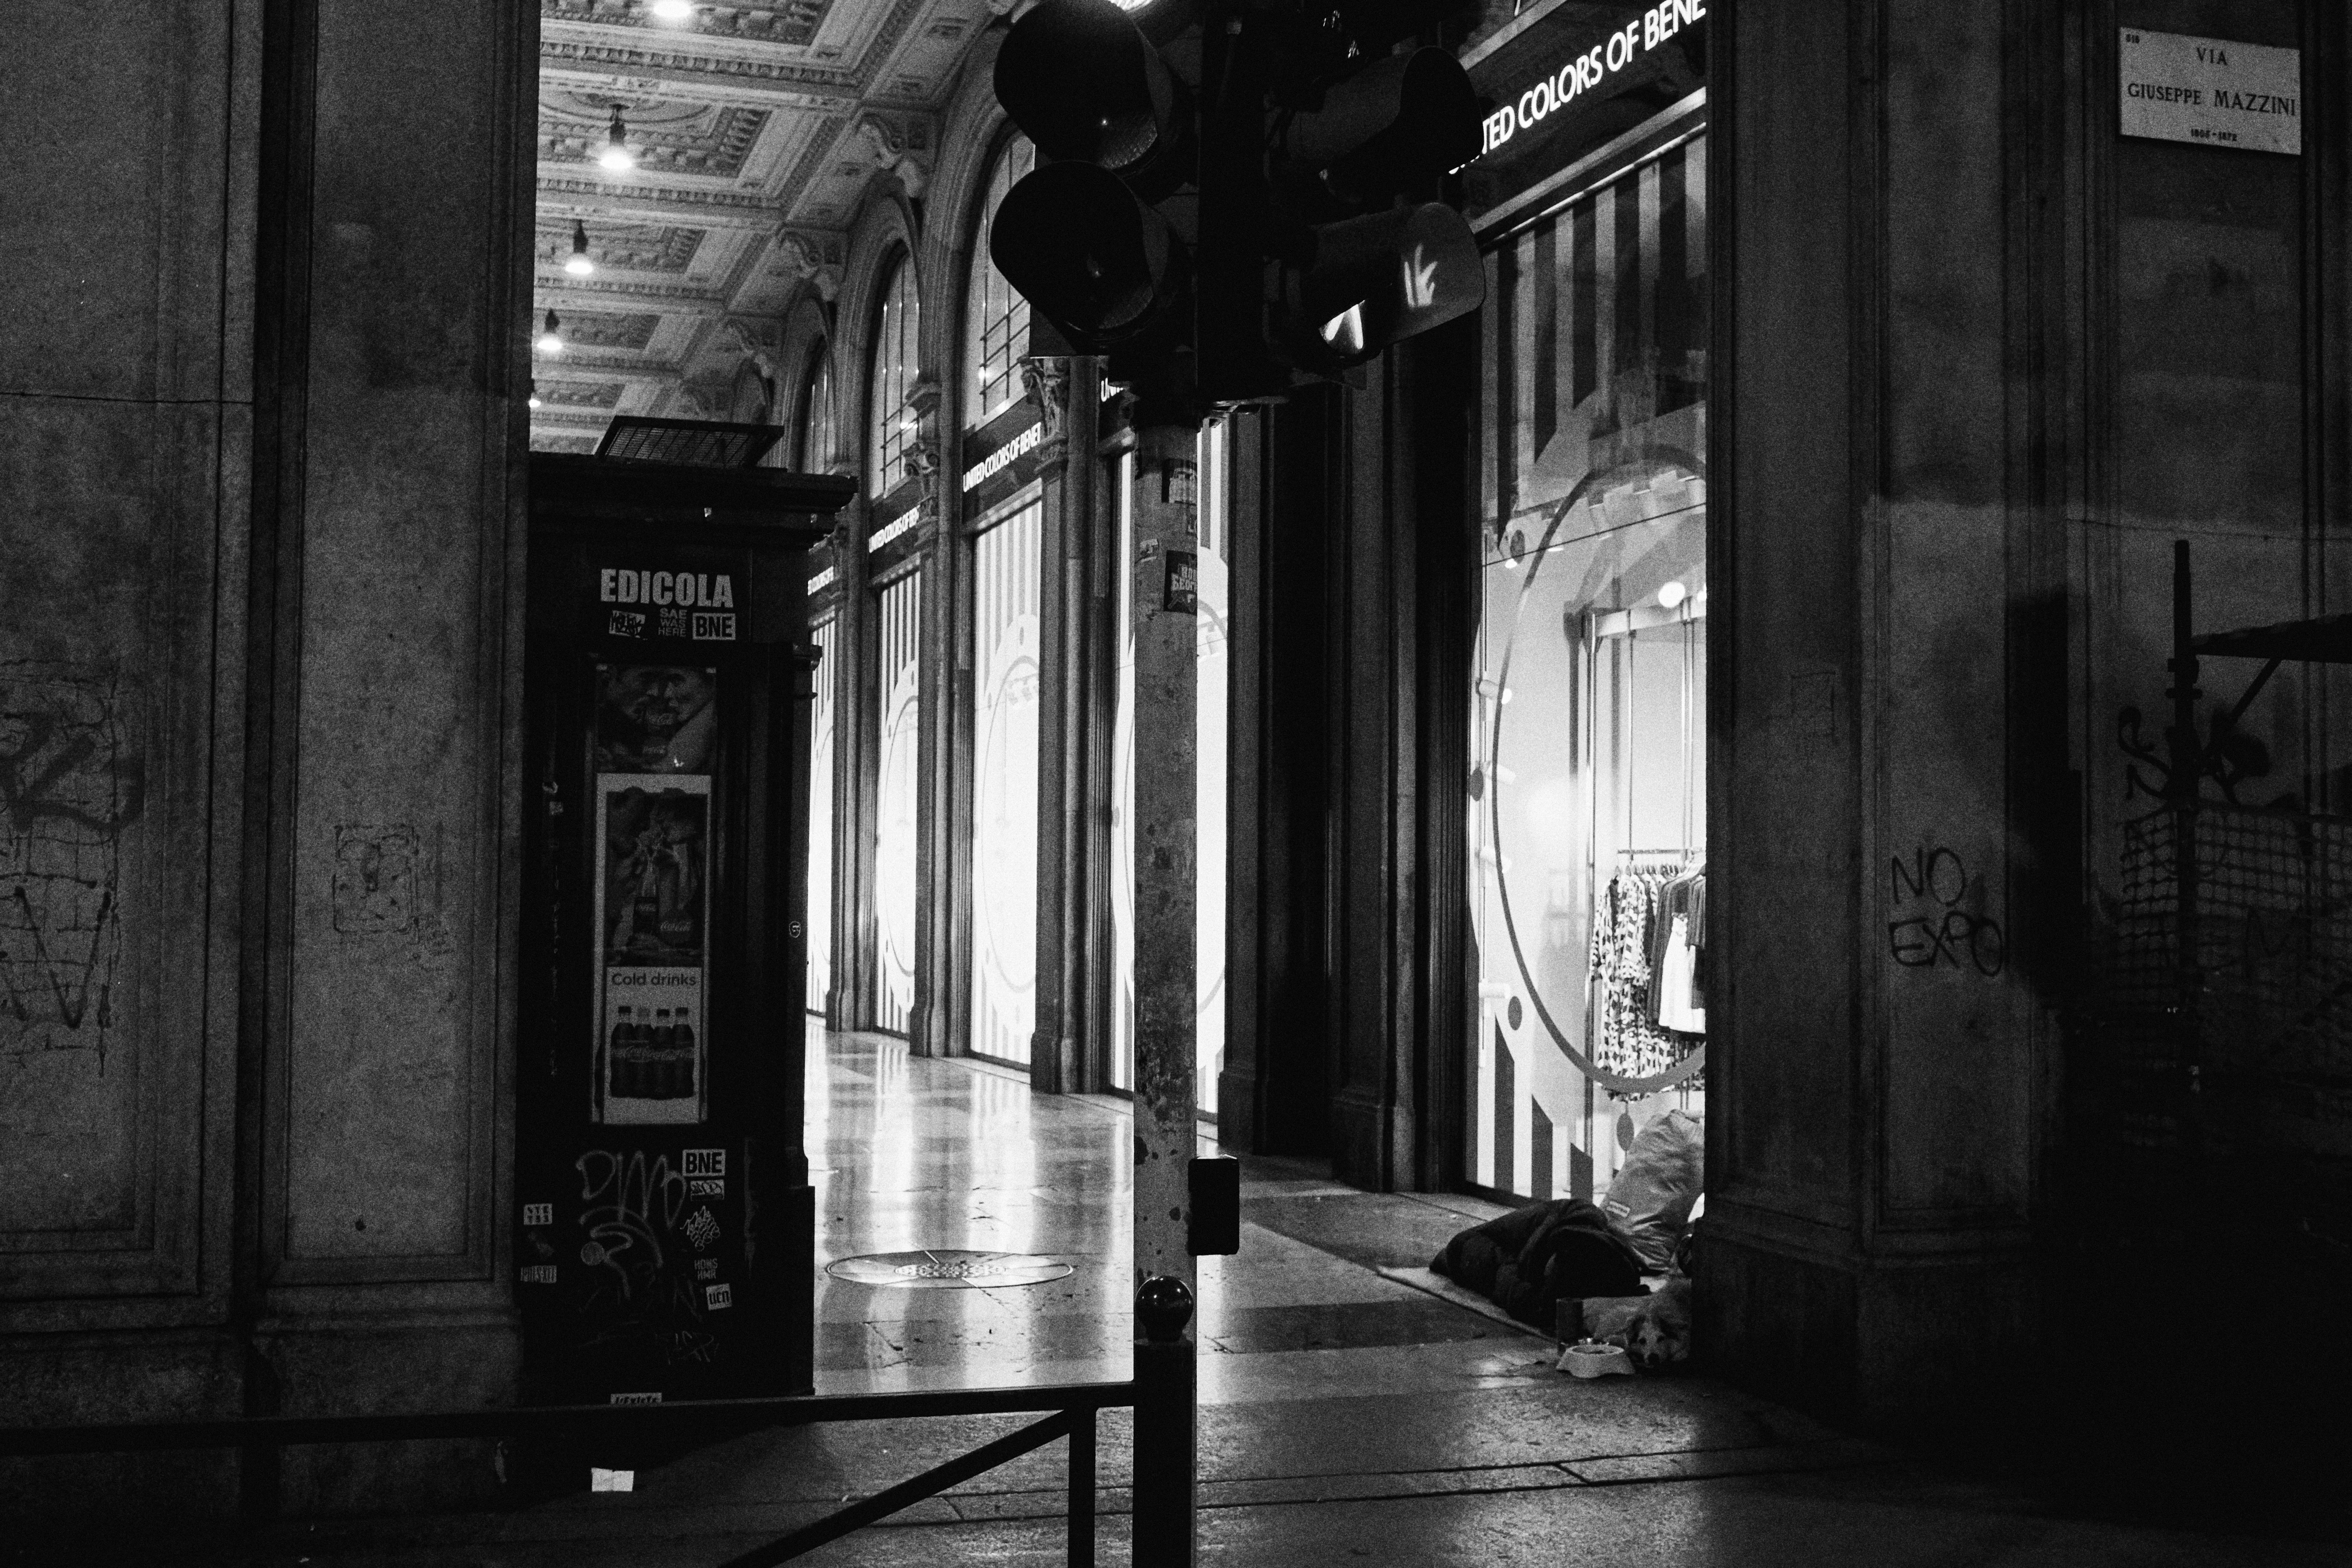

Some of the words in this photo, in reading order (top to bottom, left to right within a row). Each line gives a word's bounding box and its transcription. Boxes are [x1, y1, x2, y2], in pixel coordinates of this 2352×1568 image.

[2197, 47, 2228, 65] VIA
[1518, 45, 1603, 129] COLORS
[1606, 20, 1639, 72] OF
[2127, 83, 2202, 105] GIUSEPPE
[2214, 90, 2296, 116] MAZZINI
[601, 569, 734, 608] EDICOLA
[696, 616, 733, 637] BNE
[1892, 846, 1966, 907] NO
[1889, 911, 2002, 977] EXPO
[611, 973, 646, 986] Cold
[651, 973, 697, 986] drinks
[685, 1152, 722, 1173] BNE
